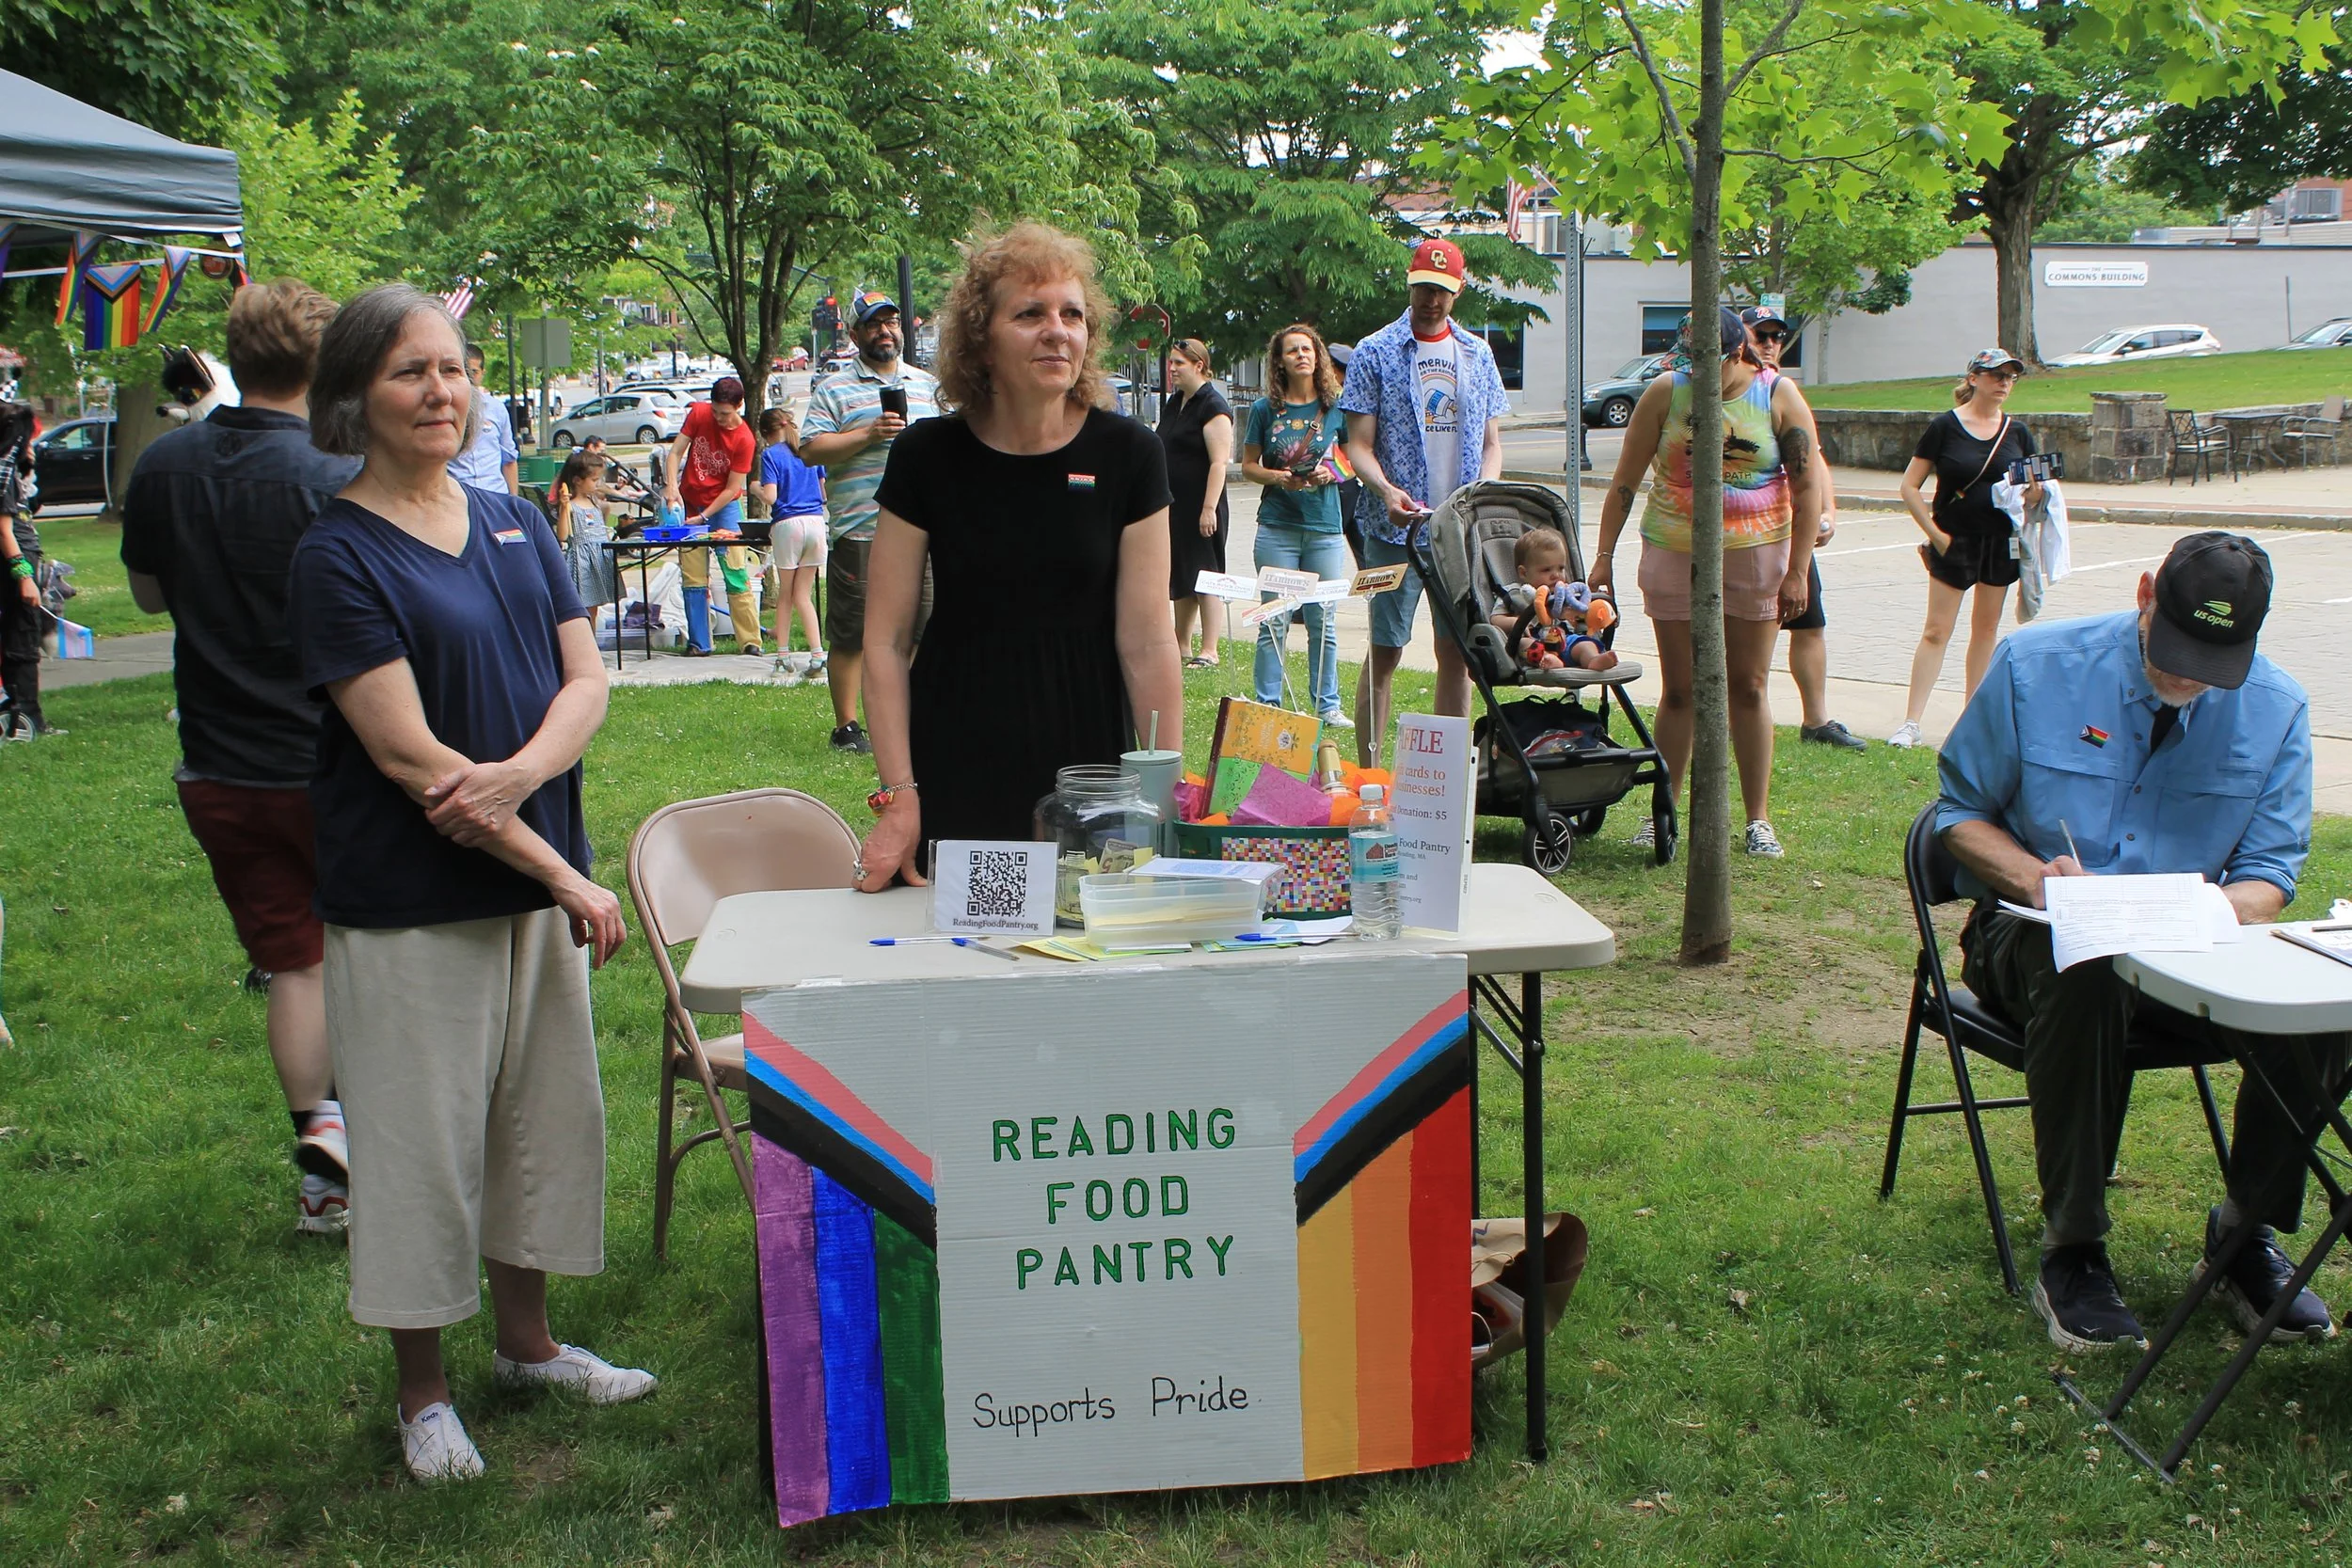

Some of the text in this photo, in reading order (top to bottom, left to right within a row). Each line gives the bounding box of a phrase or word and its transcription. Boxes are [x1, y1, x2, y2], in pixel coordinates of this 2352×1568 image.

[2048, 273, 2145, 281] COMMONS BUILDING
[1724, 471, 1752, 480] PATH
[1264, 574, 1310, 587] HARROWS
[1358, 573, 1398, 585] HARROWS
[2194, 610, 2234, 628] us open
[1406, 766, 1429, 779] cards
[1433, 770, 1446, 781] to
[1397, 805, 1448, 820] Donation: $5
[1399, 838, 1451, 855] Food Pantry
[953, 918, 1039, 930] ReadingFoodPantry.org
[993, 1108, 1235, 1162] READING
[1047, 1175, 1188, 1225] FOOD
[1017, 1235, 1233, 1290] PANTRY
[973, 1375, 1249, 1438] Supports Pride
[421, 1412, 439, 1423] Keds
